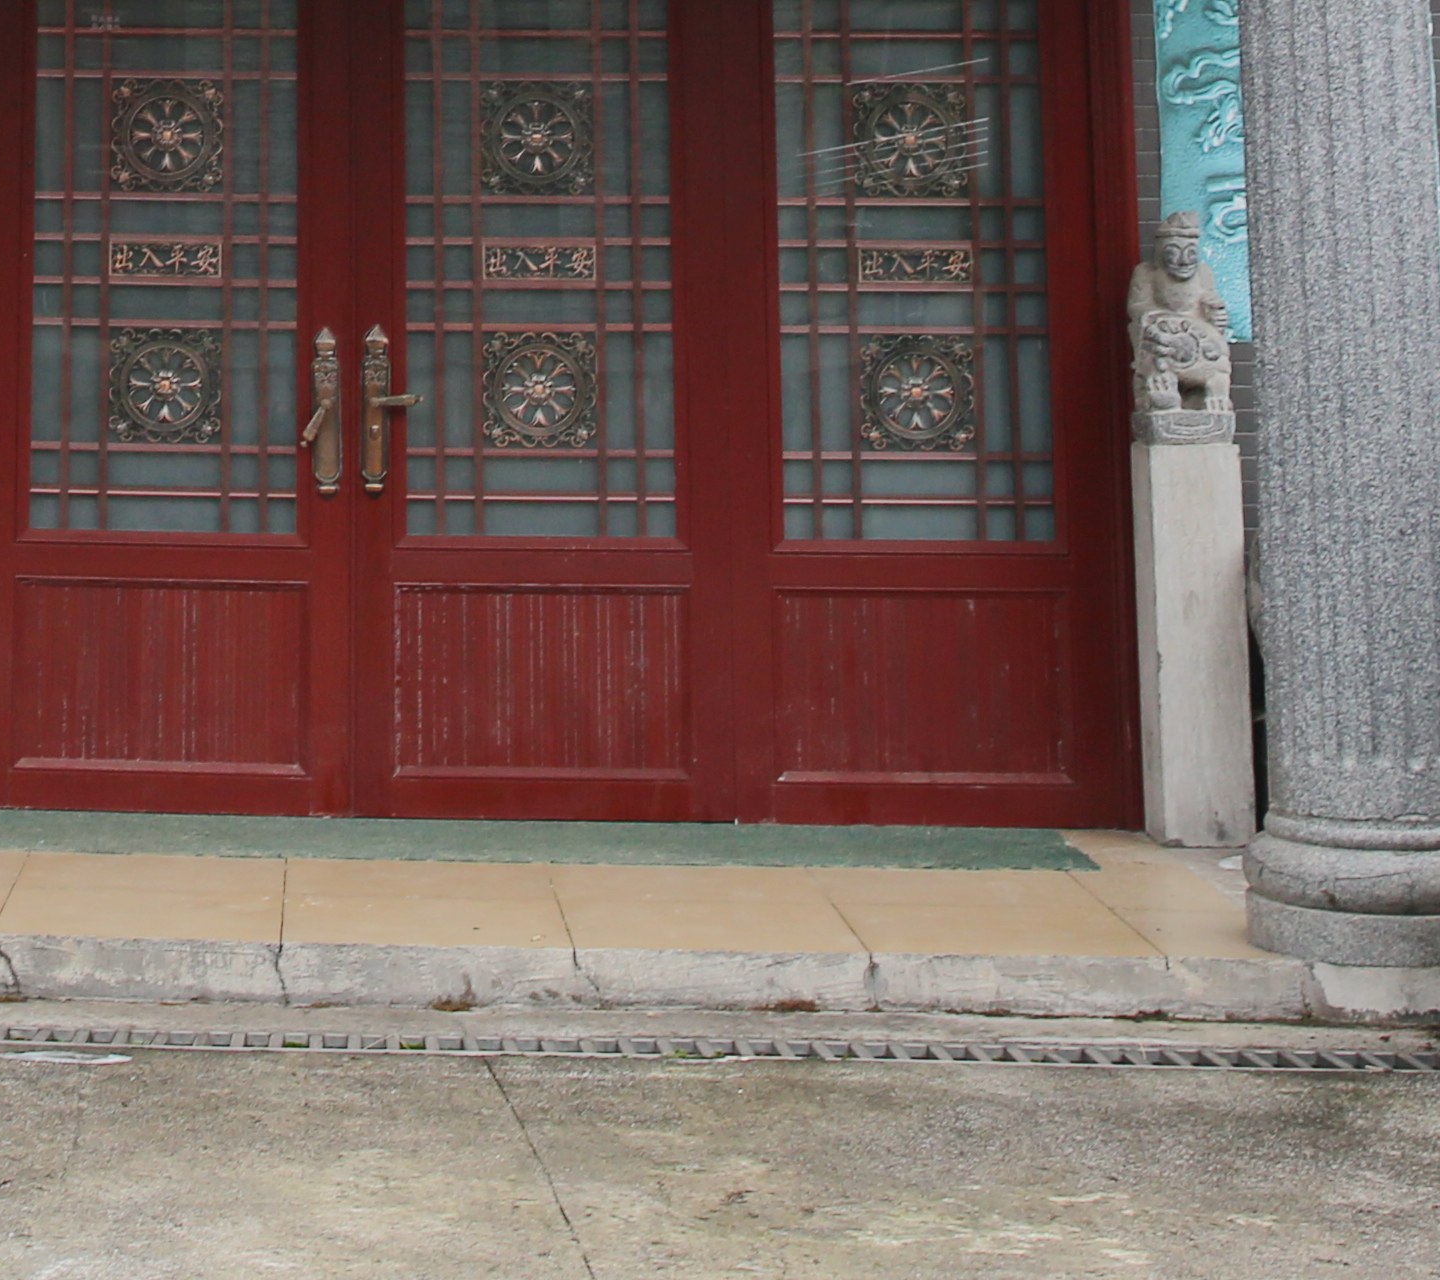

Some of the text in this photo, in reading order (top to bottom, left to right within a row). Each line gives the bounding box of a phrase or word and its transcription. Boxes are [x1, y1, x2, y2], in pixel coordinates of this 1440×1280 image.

[112, 243, 220, 275] 出入平安
[486, 247, 595, 277] 出入平安
[863, 251, 972, 281] 出入平安
